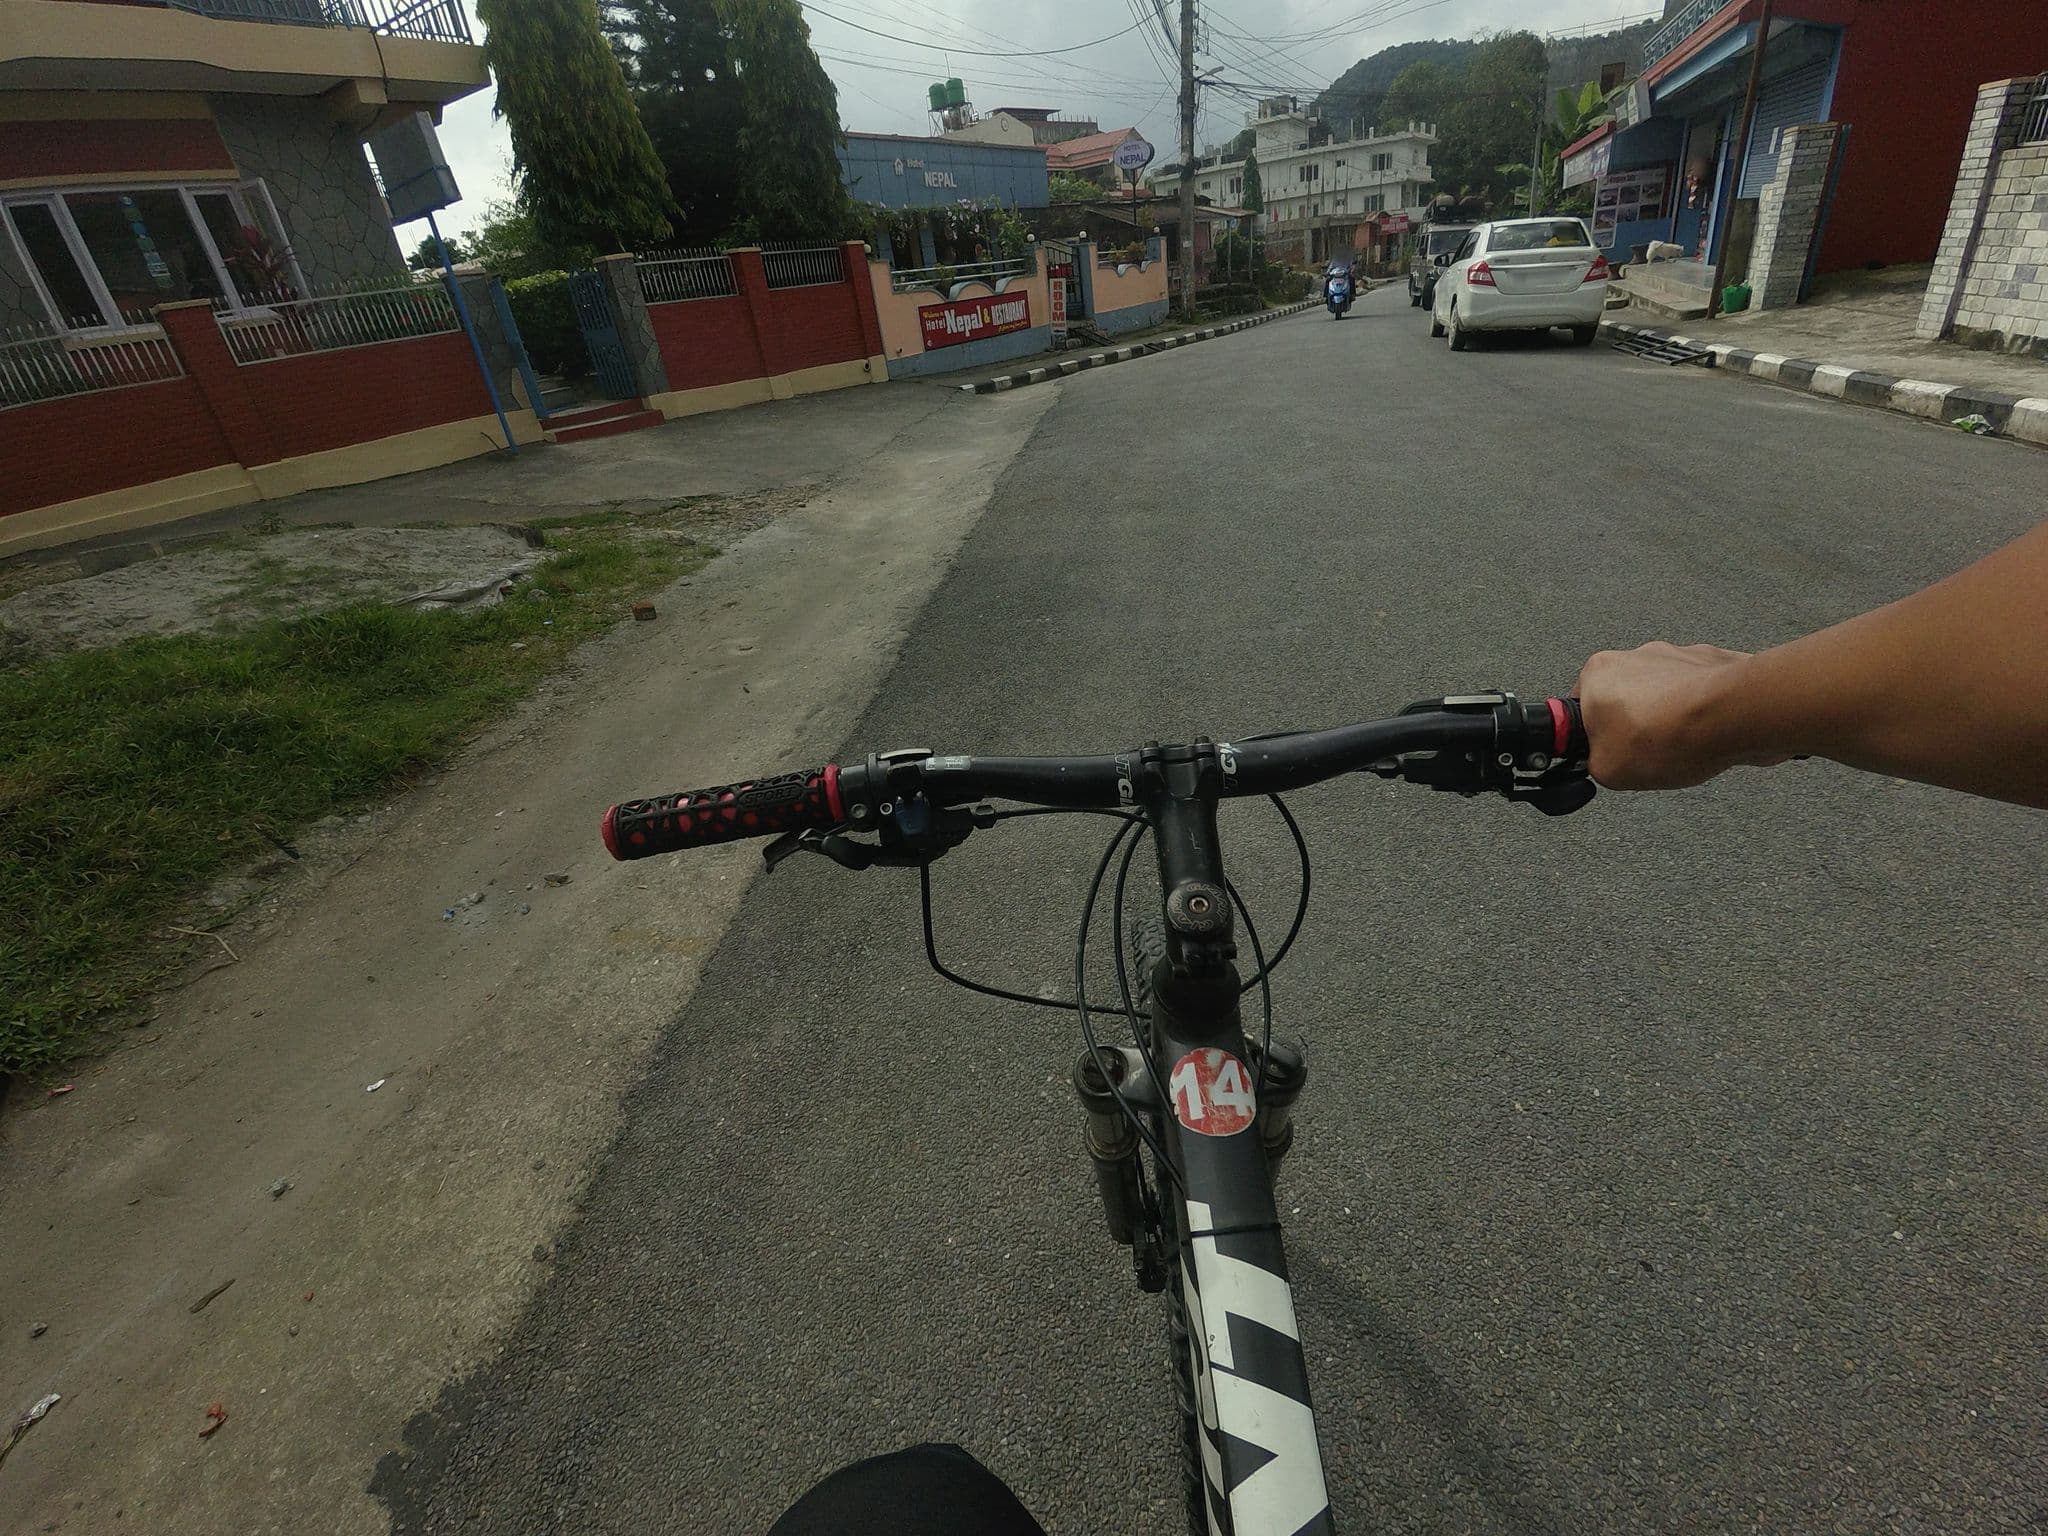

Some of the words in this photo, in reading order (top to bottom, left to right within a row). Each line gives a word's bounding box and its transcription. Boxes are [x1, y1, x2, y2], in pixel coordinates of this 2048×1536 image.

[1120, 152, 1146, 166] NEPAL
[925, 171, 958, 188] NEPAL
[1052, 281, 1065, 321] ROOM
[925, 317, 946, 331] Hotel
[944, 305, 984, 337] Nepal
[983, 307, 991, 324] &
[1169, 1059, 1251, 1121] 14
